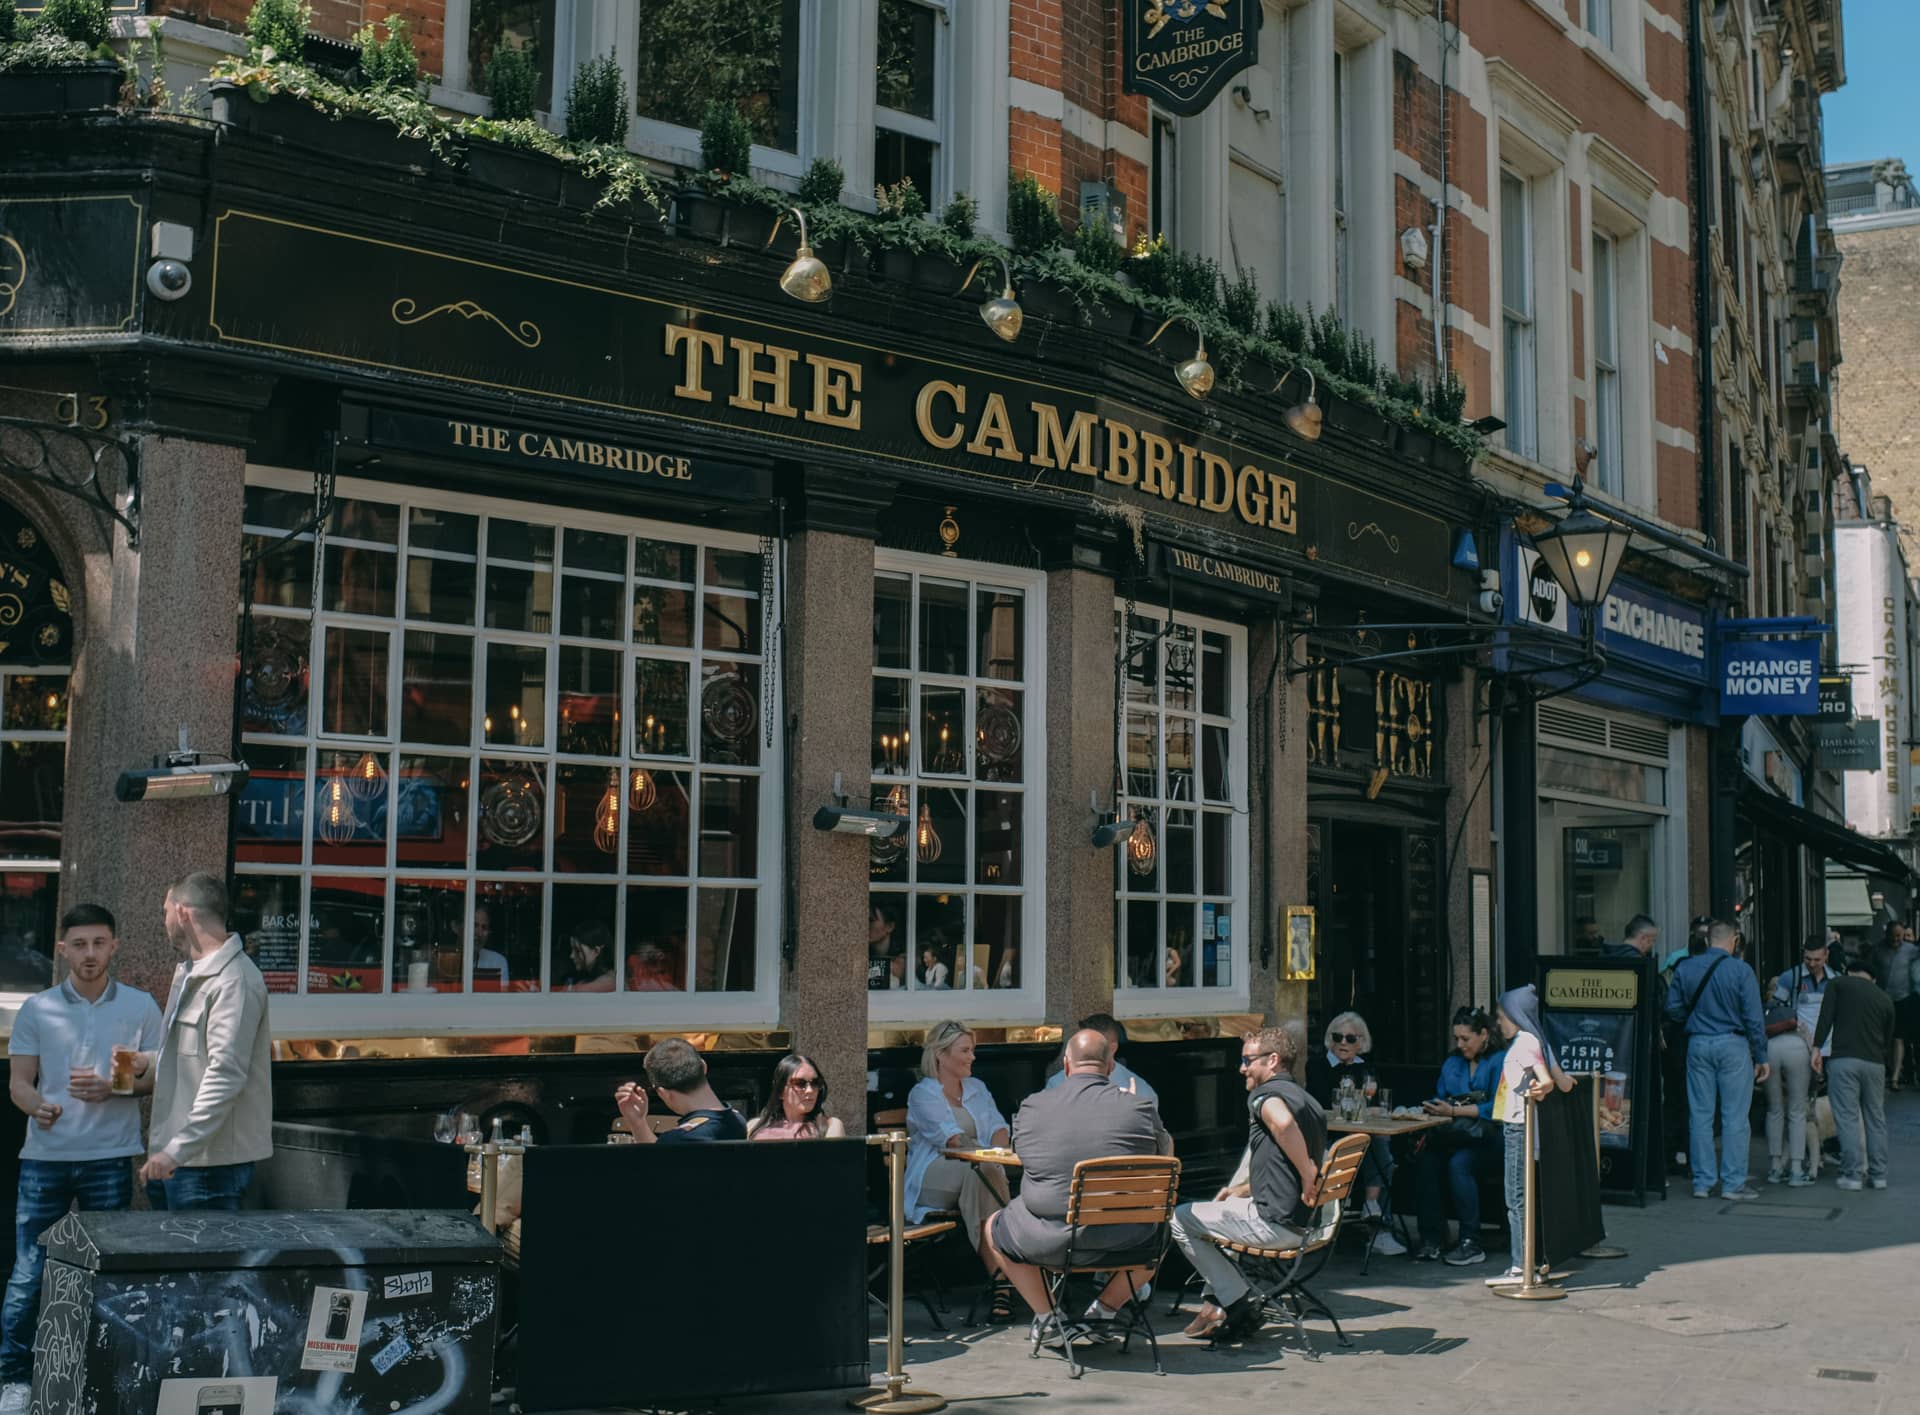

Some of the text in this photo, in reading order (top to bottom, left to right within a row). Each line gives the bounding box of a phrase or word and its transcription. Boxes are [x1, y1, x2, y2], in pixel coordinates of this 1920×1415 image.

[1172, 27, 1205, 45] THE
[1136, 32, 1244, 72] CAMBRIDGE
[665, 322, 1298, 535] THE CAMBRIDGE
[448, 421, 693, 481] THE CAMBRIDGE
[1171, 547, 1281, 594] THE CAMBRIDGE
[1602, 594, 1705, 660] EXCHANGE
[1727, 660, 1812, 676] CHANGE
[1726, 676, 1812, 696] MONEY
[262, 914, 285, 929] BAR
[1580, 978, 1602, 987] THE
[1550, 987, 1633, 999] CAMBRIDGE
[1560, 1045, 1614, 1058] FISH &
[1560, 1058, 1612, 1072] CHIPS
[307, 1340, 358, 1353] MISSING PHONE
